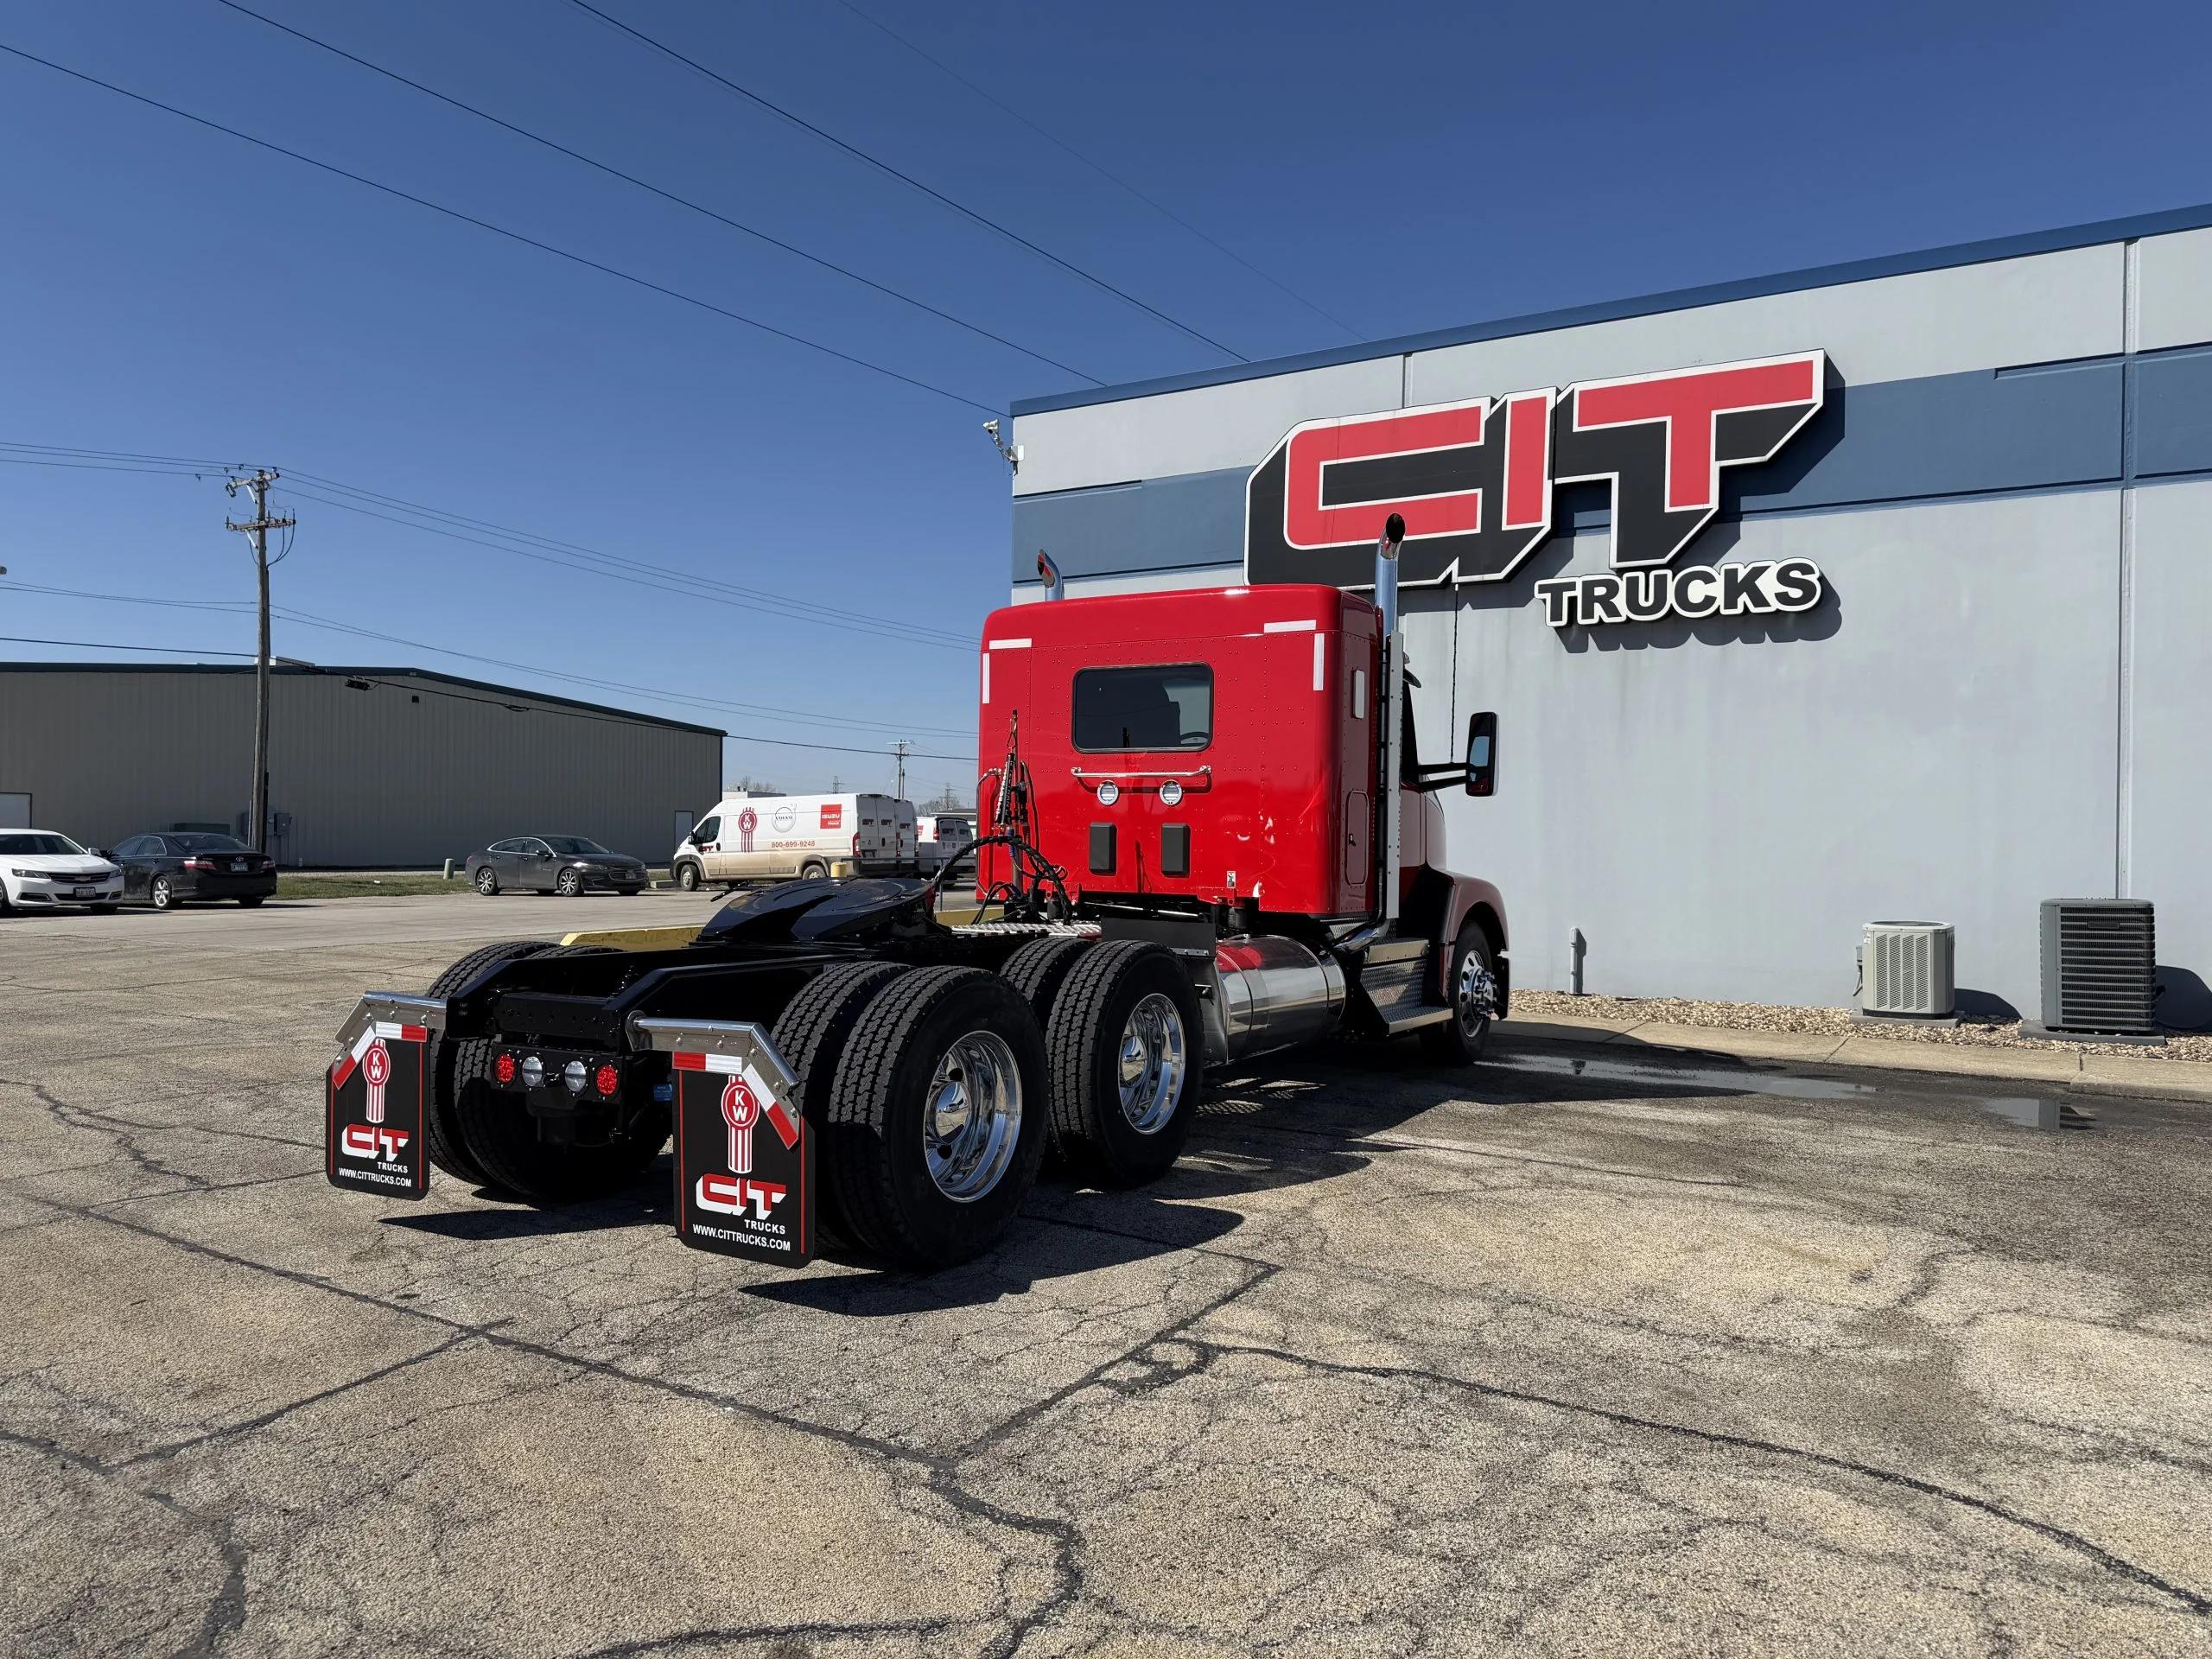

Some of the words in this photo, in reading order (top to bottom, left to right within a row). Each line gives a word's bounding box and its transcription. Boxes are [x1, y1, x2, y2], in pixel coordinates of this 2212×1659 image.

[1245, 348, 1825, 585] CIT
[1536, 559, 1821, 626] TRUCKS
[771, 840, 816, 849] 800-699-9248
[342, 1124, 410, 1161] CIT
[339, 1167, 412, 1188] WWW.CITTRUCKS.COM
[377, 1161, 409, 1174] TRUCKS
[696, 1173, 787, 1220] CIT
[692, 1224, 791, 1251] WWW.CITTRUCKS.COM
[744, 1219, 786, 1235] TRUCKS
